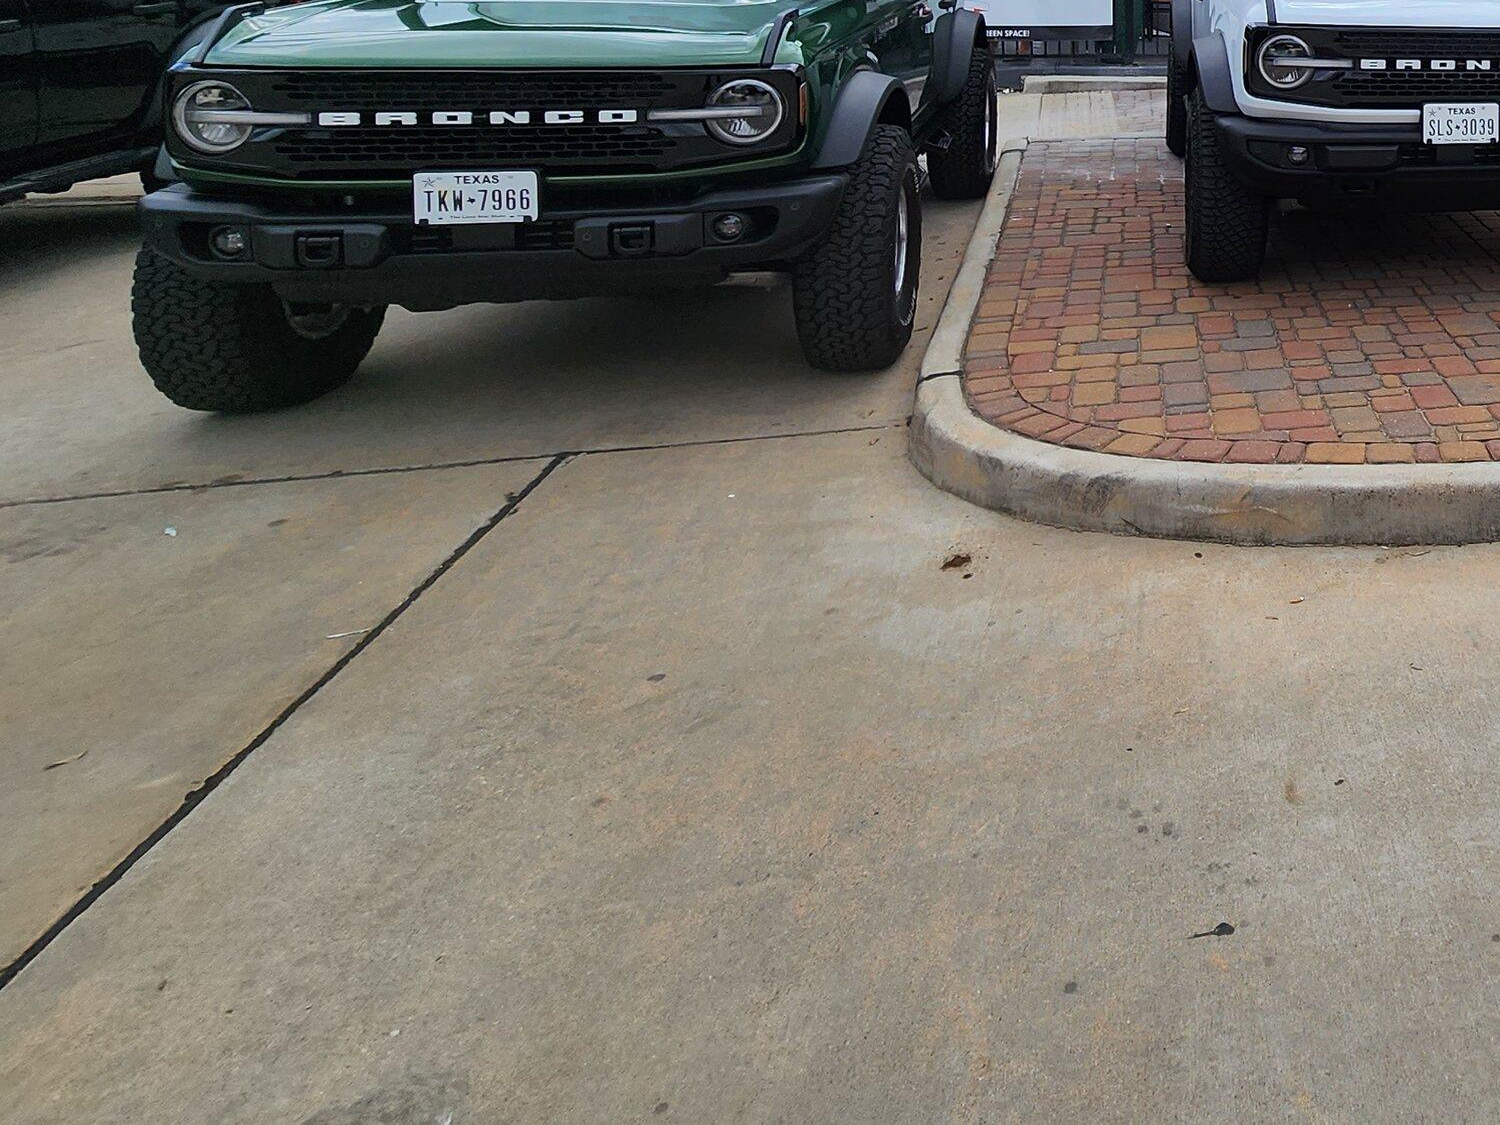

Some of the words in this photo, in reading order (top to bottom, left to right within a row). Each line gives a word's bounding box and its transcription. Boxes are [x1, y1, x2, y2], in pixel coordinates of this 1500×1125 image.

[318, 109, 637, 125] BRONCO
[1429, 119, 1453, 136] SLS
[1462, 119, 1494, 135] 3039
[454, 175, 499, 184] TEXAS
[424, 190, 463, 212] TKW
[478, 189, 530, 211] 7966
